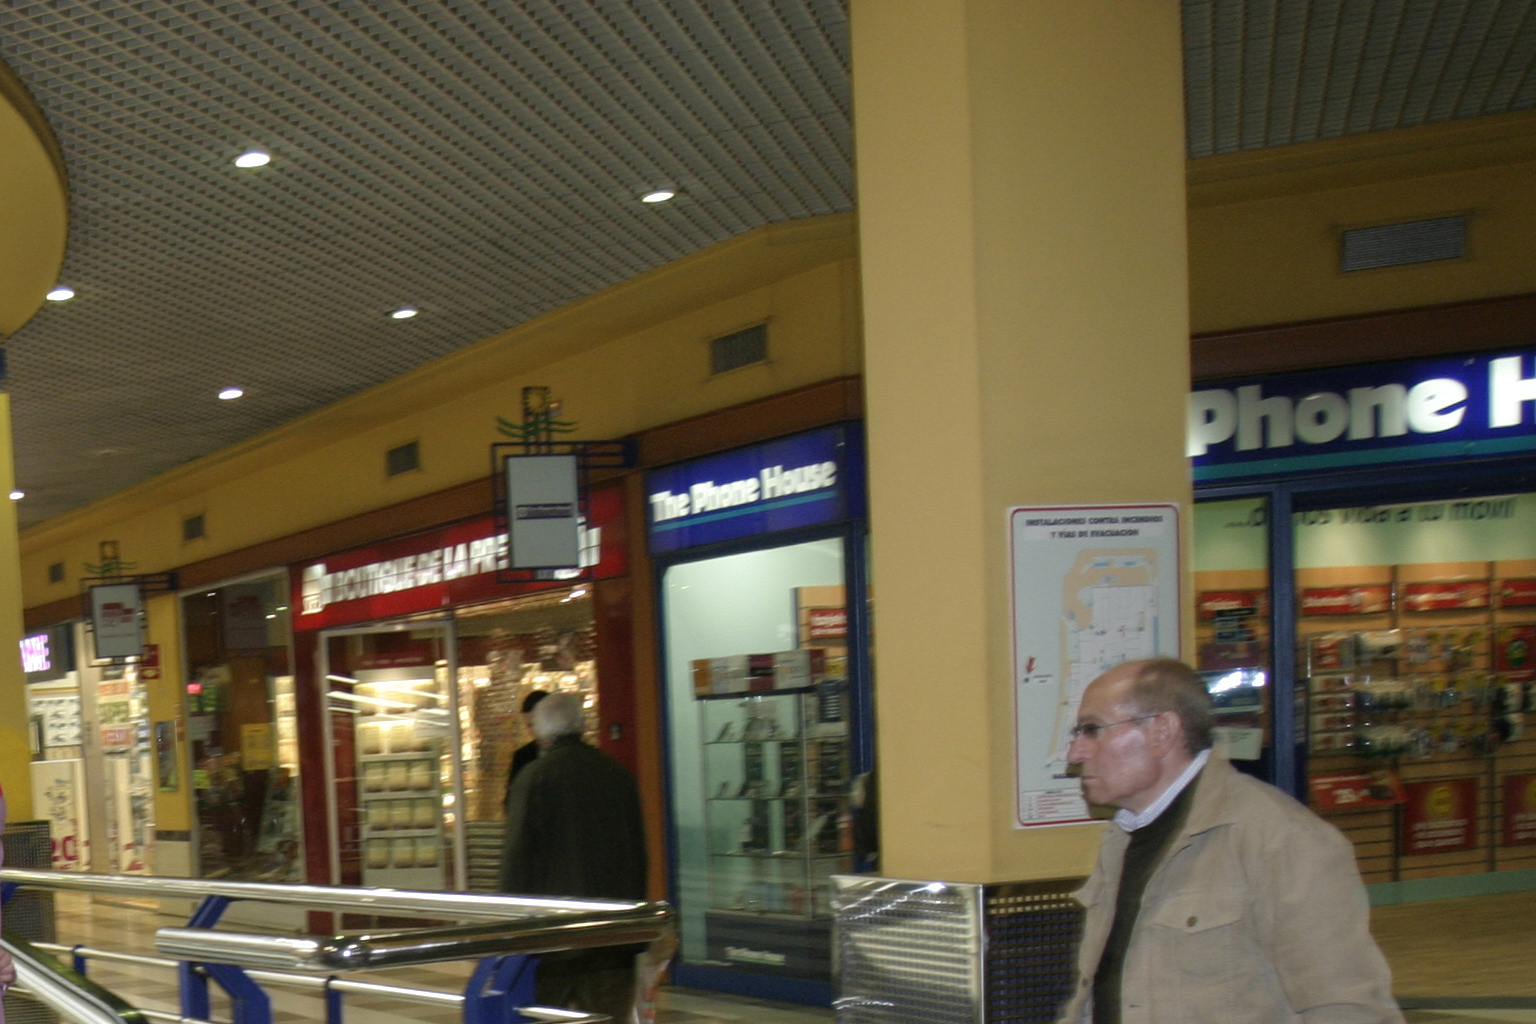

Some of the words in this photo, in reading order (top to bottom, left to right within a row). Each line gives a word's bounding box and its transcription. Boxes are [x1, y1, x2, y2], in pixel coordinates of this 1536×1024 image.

[1186, 376, 1469, 458] Phone
[649, 489, 690, 523] The
[690, 476, 760, 515] Phone
[760, 460, 837, 500] House
[1025, 517, 1086, 527] INSTALACIONES
